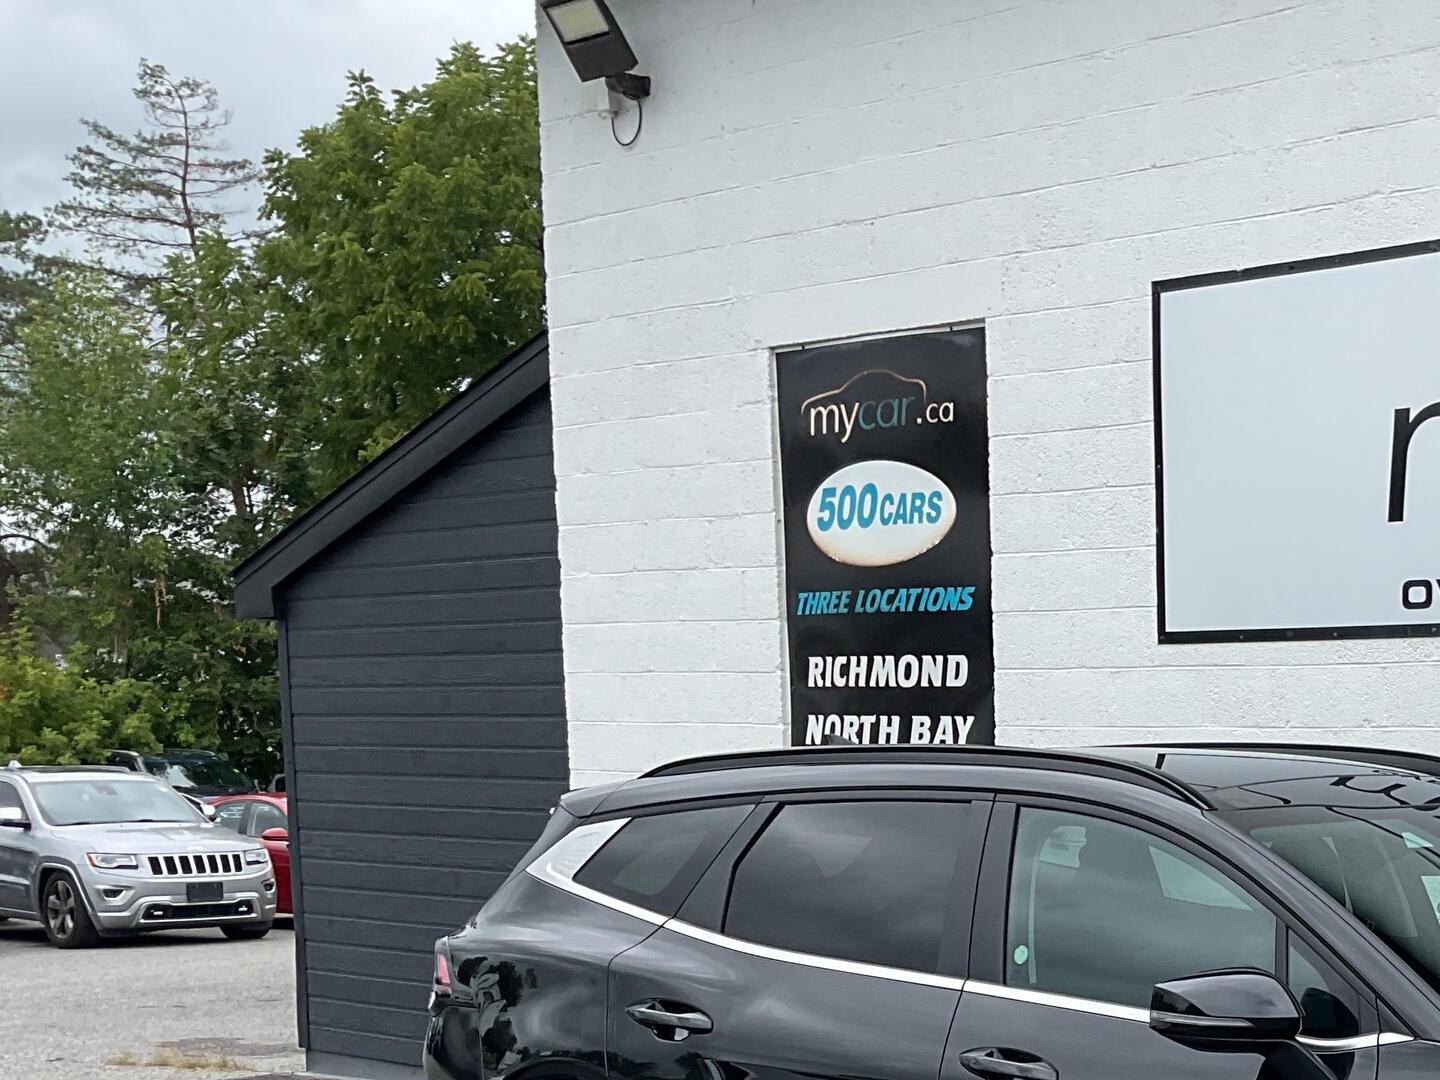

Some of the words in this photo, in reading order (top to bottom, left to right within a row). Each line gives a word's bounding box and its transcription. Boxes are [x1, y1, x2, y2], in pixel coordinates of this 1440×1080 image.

[809, 396, 955, 443] mycar.ca
[797, 590, 850, 615] THREE
[854, 586, 975, 614] LOCATIONS
[807, 654, 969, 689] RICHMOND
[804, 713, 902, 746] NORTH
[908, 714, 976, 746] BAY
